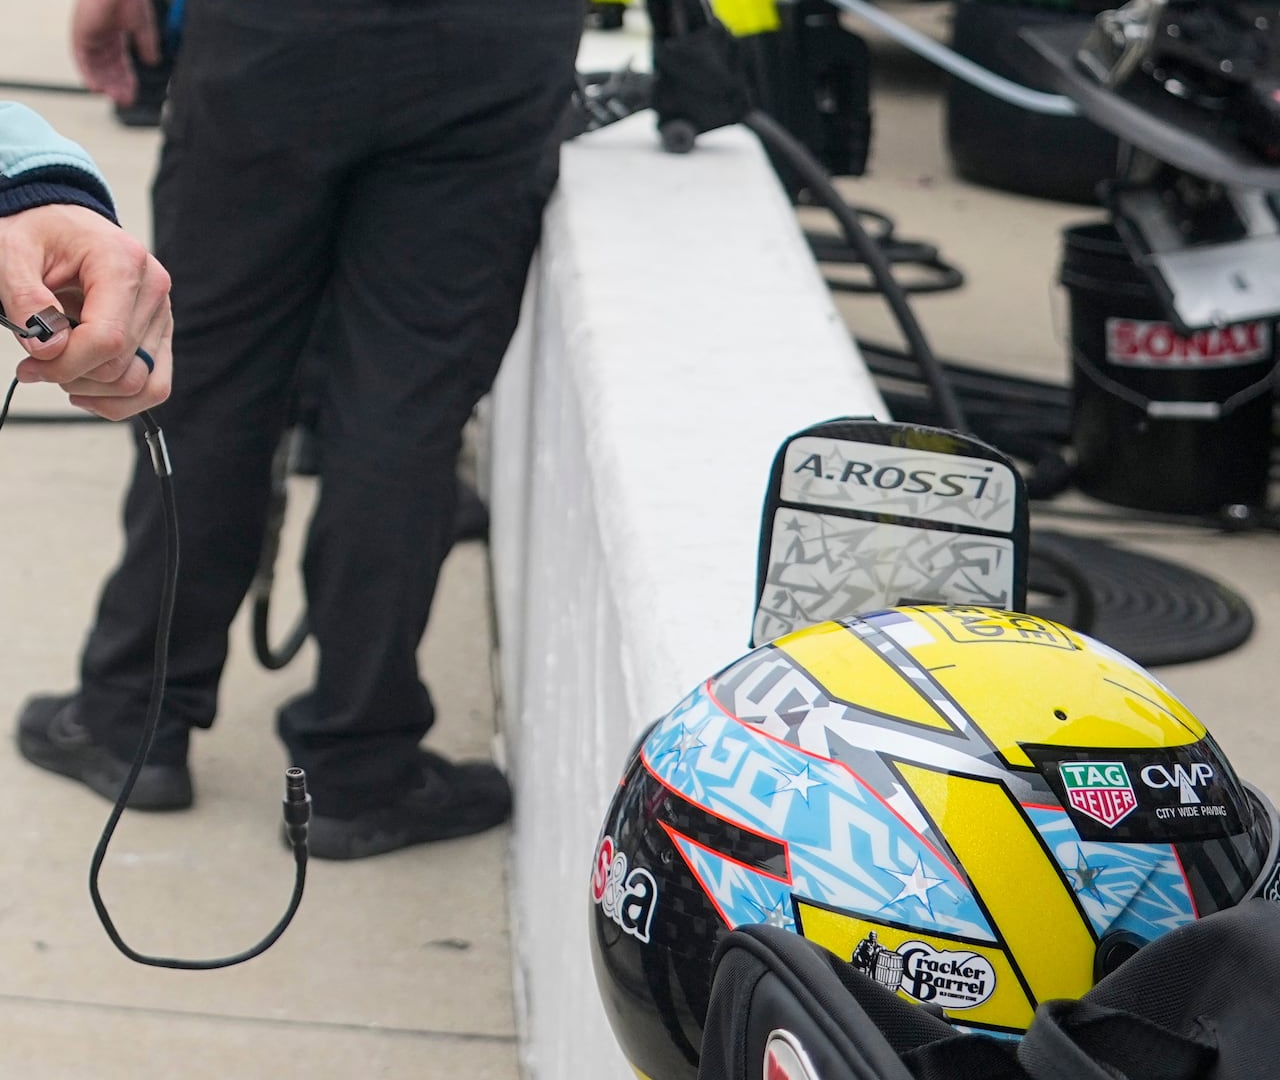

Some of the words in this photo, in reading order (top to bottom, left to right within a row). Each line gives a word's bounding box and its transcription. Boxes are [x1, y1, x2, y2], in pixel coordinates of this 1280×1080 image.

[1065, 766, 1123, 787] TAG
[1073, 789, 1134, 822] HEUER
[1155, 807, 1176, 819] CITY
[1177, 806, 1199, 818] WIDE
[1200, 804, 1227, 817] PAVING
[903, 948, 986, 982] Cracker
[912, 969, 985, 1001] Barrel
